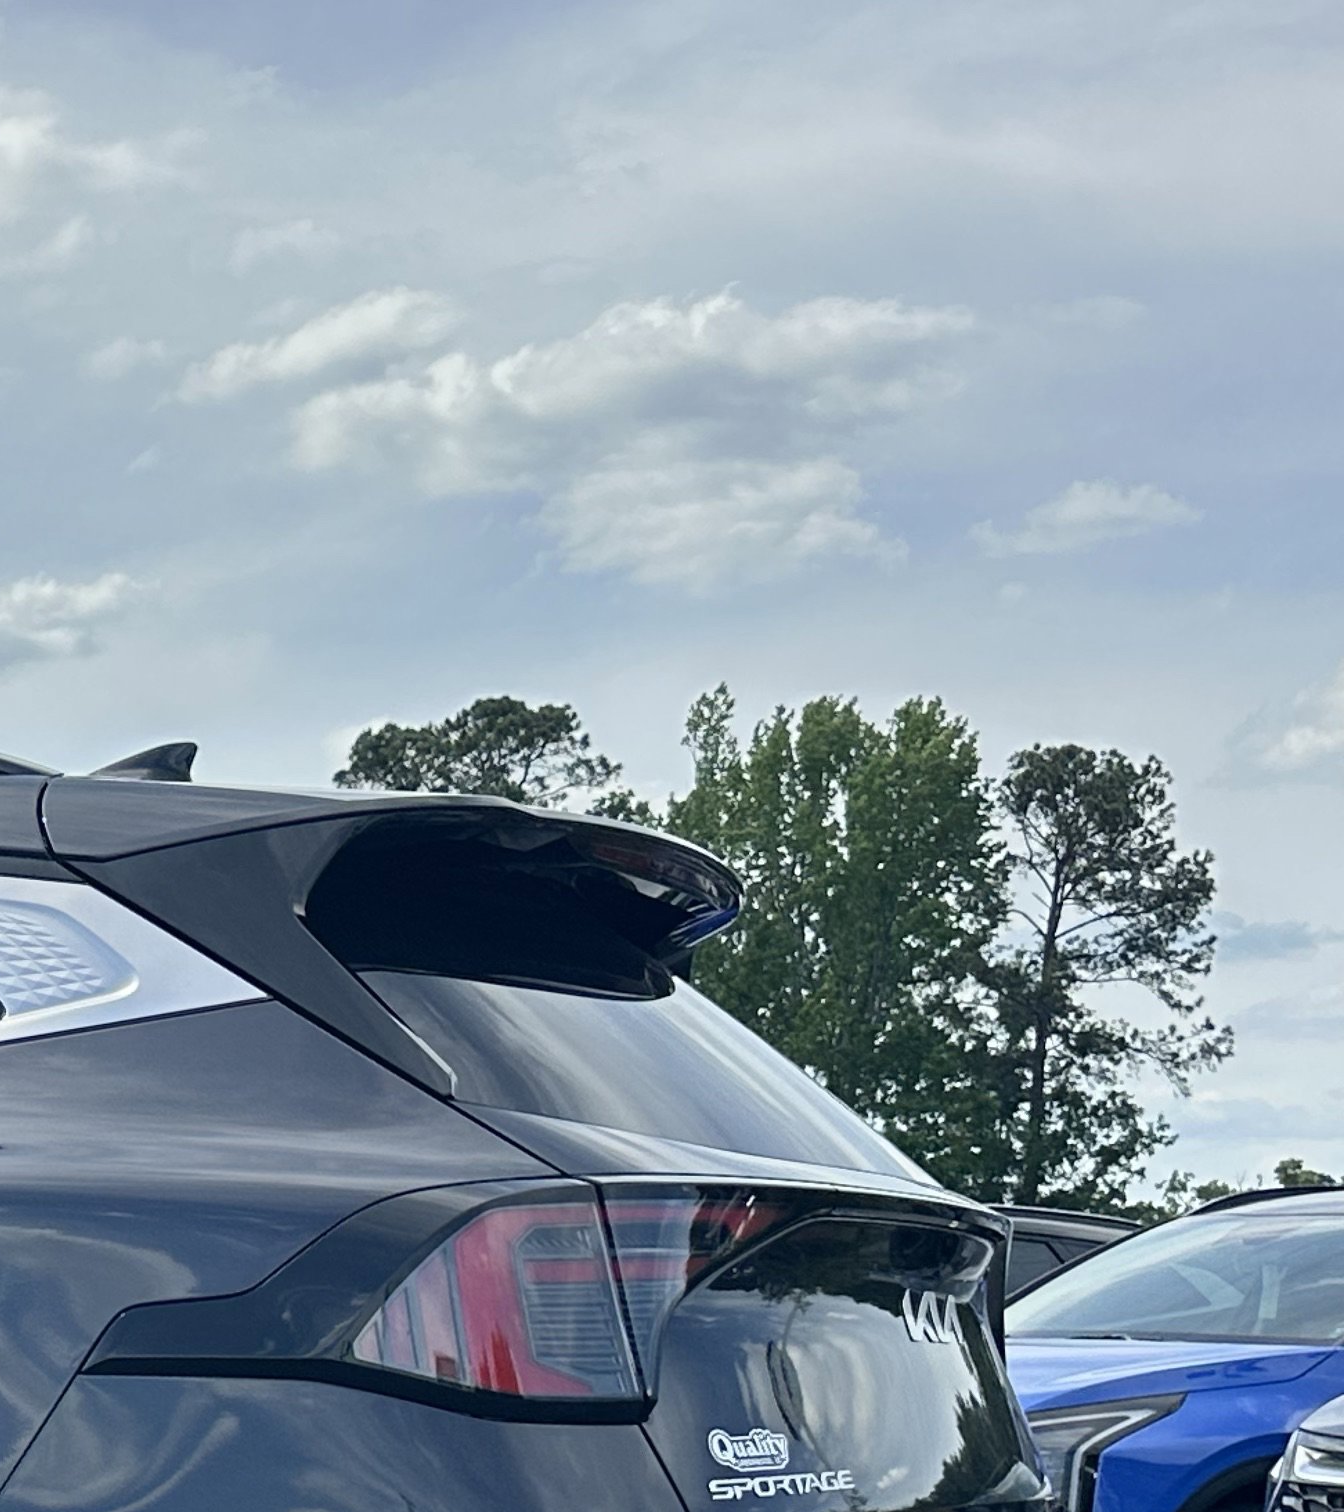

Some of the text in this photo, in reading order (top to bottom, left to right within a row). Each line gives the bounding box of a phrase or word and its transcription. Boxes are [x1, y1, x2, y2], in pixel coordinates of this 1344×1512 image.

[902, 1288, 964, 1344] KIA
[712, 1432, 786, 1465] Quality
[708, 1469, 856, 1500] SPORTAGE
